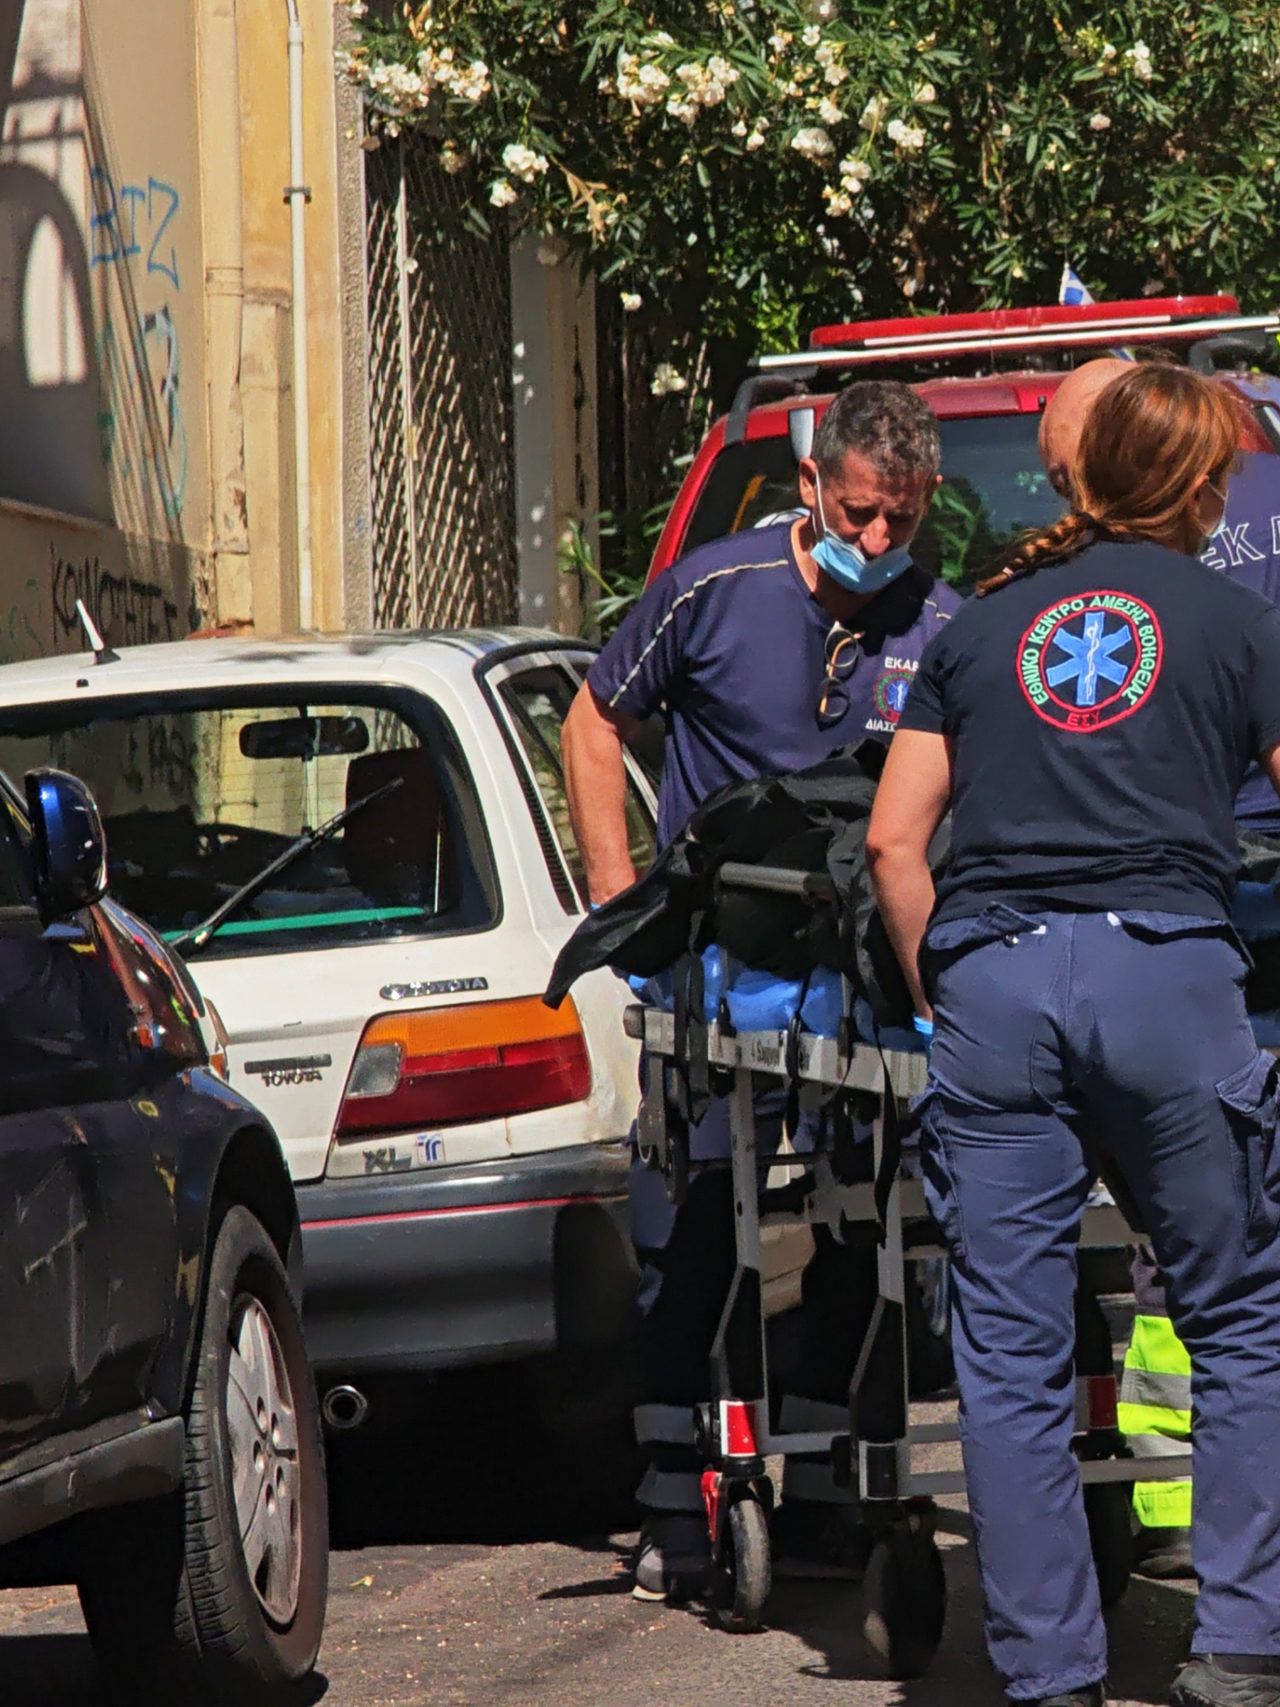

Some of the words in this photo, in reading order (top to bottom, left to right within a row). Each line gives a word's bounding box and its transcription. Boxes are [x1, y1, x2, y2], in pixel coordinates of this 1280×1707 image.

[1028, 599, 1085, 645] ΚΕΝΤΡΟ
[1089, 595, 1150, 625] ΑΜΕΣΗΣ
[1022, 648, 1049, 705] ΕΘΝΙΚΟ
[1121, 625, 1157, 706] ΒΟΗΘΕΙΑΣ
[261, 1068, 323, 1087] TOYOTA
[362, 1146, 412, 1174] XL
